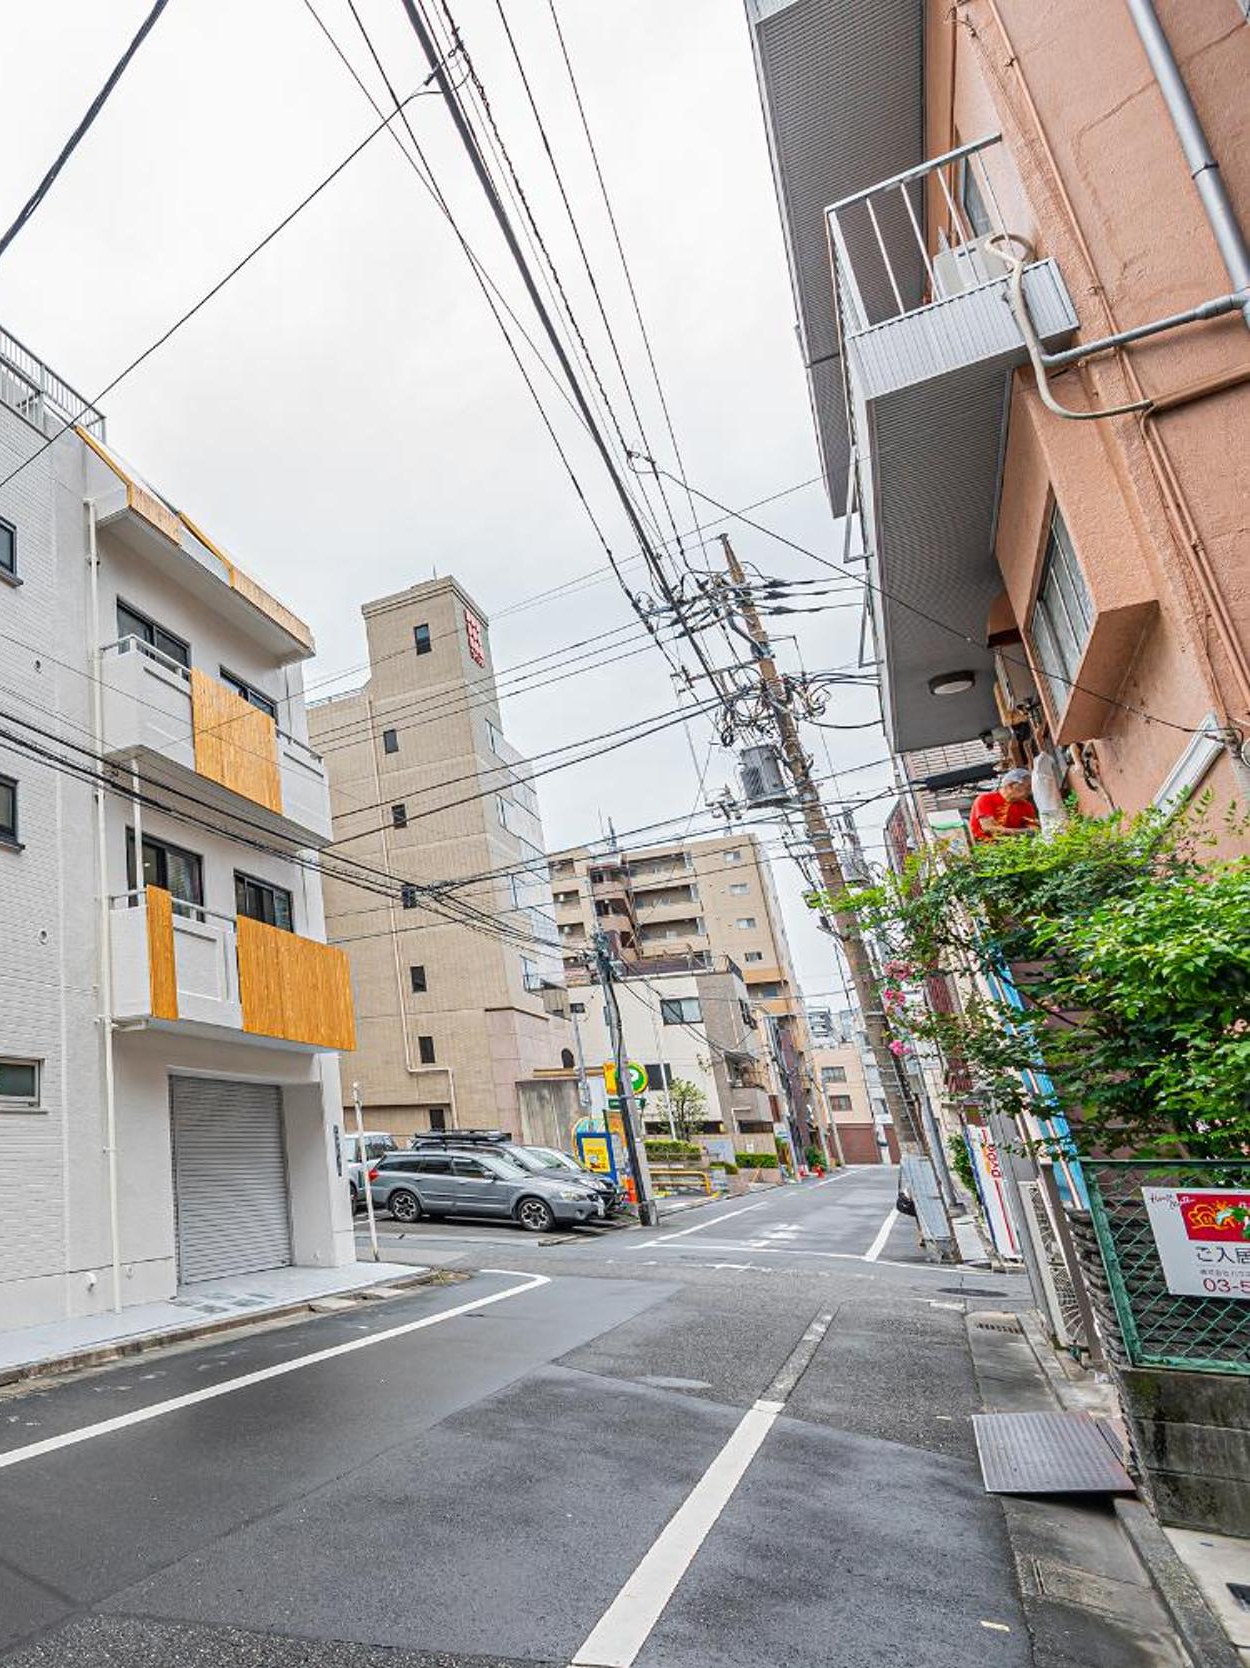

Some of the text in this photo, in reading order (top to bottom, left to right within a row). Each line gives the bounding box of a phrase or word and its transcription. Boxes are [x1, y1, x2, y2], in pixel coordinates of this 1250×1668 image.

[1195, 1246, 1250, 1264] ご入居
[1203, 1277, 1250, 1294] 03-5
